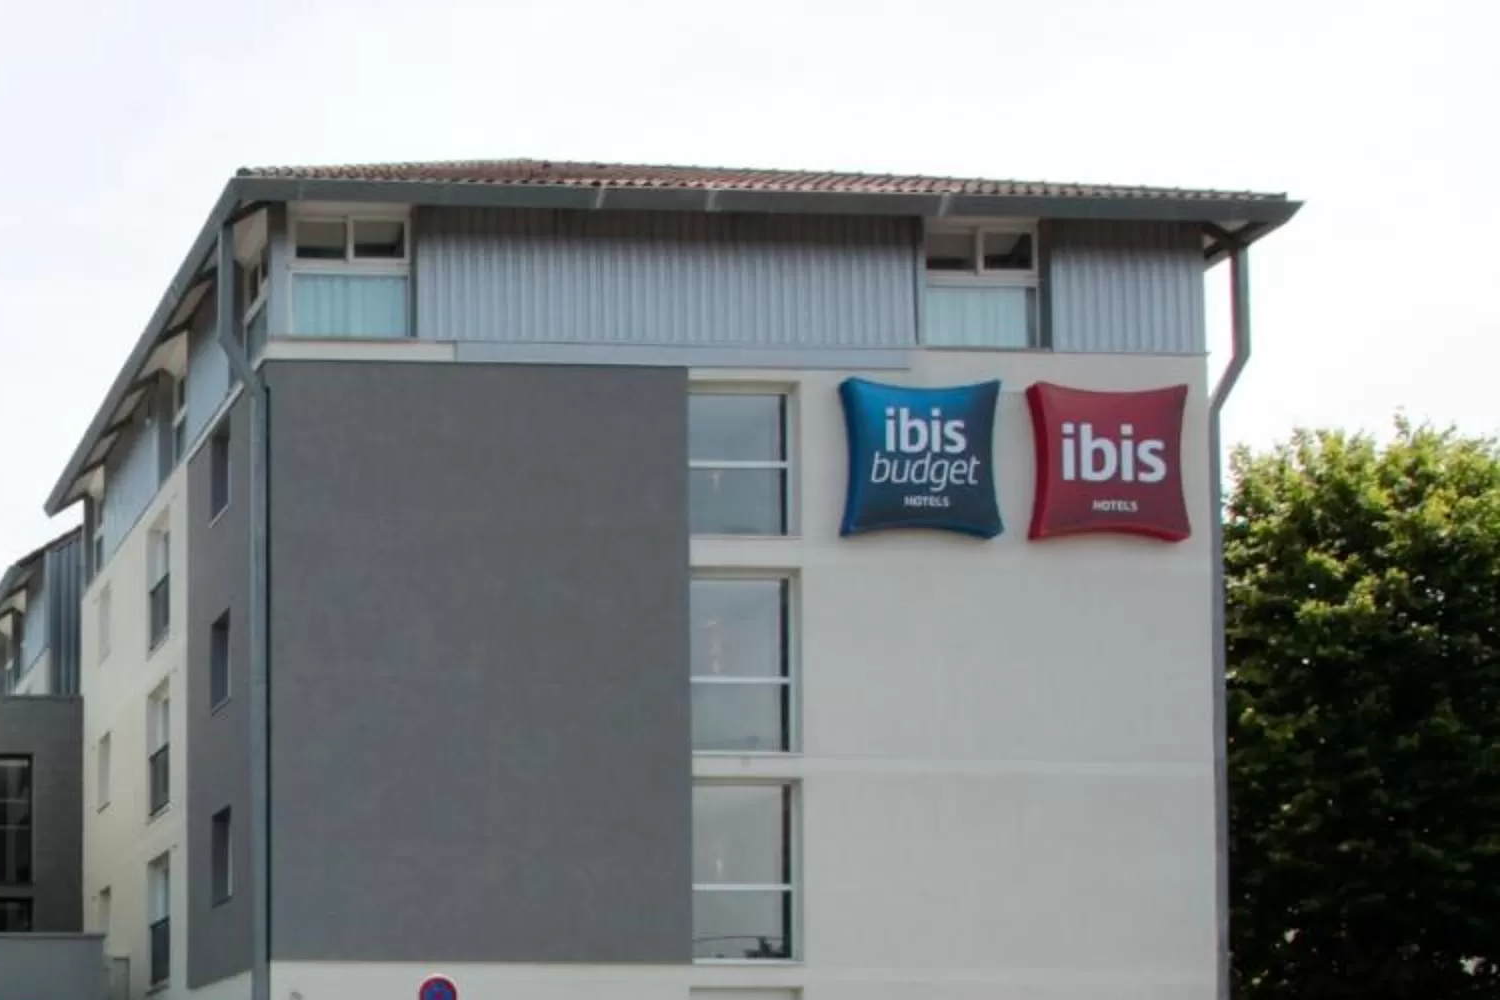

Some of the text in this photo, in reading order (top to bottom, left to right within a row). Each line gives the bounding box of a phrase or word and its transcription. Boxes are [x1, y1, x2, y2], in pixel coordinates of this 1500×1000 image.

[885, 406, 967, 453] ibis
[871, 452, 981, 492] budget
[1061, 422, 1167, 482] ibis
[904, 496, 950, 507] HOTELS
[1092, 500, 1139, 512] HOTELS
